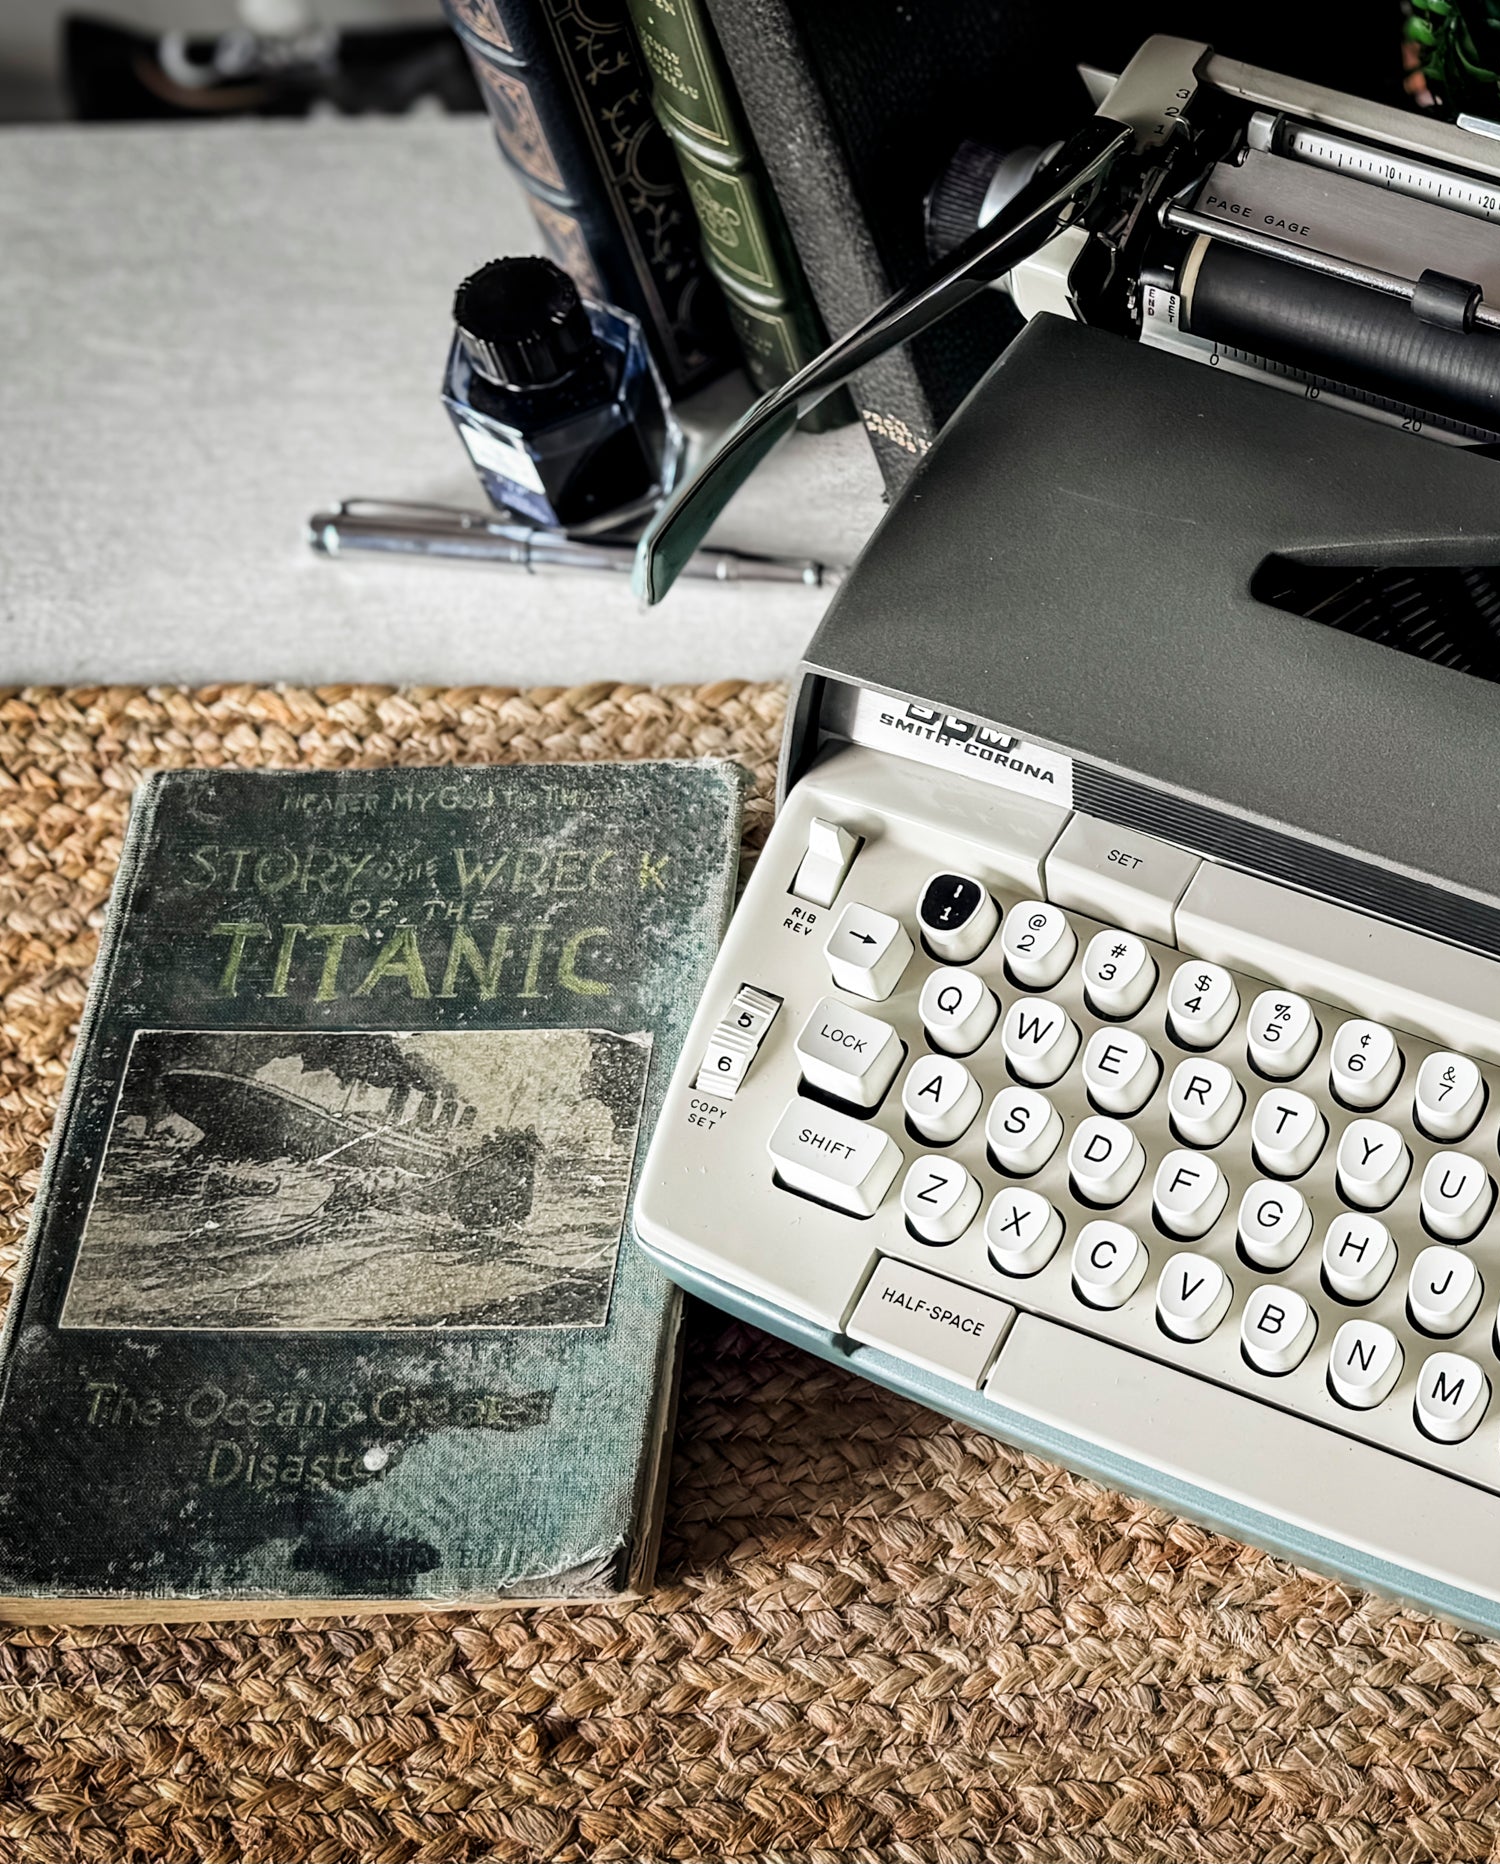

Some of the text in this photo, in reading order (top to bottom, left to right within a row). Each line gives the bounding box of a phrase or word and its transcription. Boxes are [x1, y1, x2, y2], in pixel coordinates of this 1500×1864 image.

[1176, 88, 1190, 99] 3
[1165, 107, 1179, 117] 2
[1154, 125, 1165, 135] 1
[1384, 164, 1396, 181] 10
[1482, 196, 1496, 211] 20
[1206, 196, 1311, 237] PAGE GAGE
[1147, 288, 1156, 316] END
[1168, 295, 1177, 323] SET
[1209, 353, 1423, 433] 0 10 20
[879, 712, 1055, 785] SMITH-CORONA
[391, 786, 434, 814] MY
[182, 844, 374, 897] STORY
[451, 845, 672, 899] WRECK
[1107, 849, 1144, 870] SET
[422, 899, 494, 922] THE
[791, 906, 817, 924] RIB
[939, 906, 952, 921] 1
[1028, 913, 1047, 931] @
[782, 917, 813, 936] REV
[1016, 934, 1036, 953] 2
[1110, 943, 1127, 959] #
[205, 921, 612, 1002] TITANIC
[1098, 963, 1117, 981] 3
[1194, 975, 1213, 992] $
[937, 986, 963, 1015] Q
[1183, 996, 1202, 1014] 4
[1273, 1003, 1292, 1022] %
[737, 1011, 755, 1028] 5
[1018, 1012, 1054, 1044] W
[1262, 1023, 1283, 1042] 5
[820, 1024, 868, 1054] LOCK
[717, 1055, 733, 1072] 6
[1097, 1044, 1128, 1075] E
[1347, 1053, 1367, 1072] 6
[917, 1075, 943, 1103] A
[1442, 1066, 1456, 1084] &
[1183, 1075, 1212, 1106] R
[1438, 1082, 1454, 1102] 7
[687, 1113, 716, 1131] SET
[689, 1098, 727, 1119] COPY
[1003, 1106, 1030, 1134] S
[1275, 1105, 1299, 1134] T
[798, 1128, 856, 1160] SHIFT
[1083, 1134, 1113, 1163] D
[1361, 1136, 1384, 1166] Y
[916, 1173, 949, 1204] Z
[1169, 1167, 1201, 1193] F
[1439, 1169, 1467, 1199] U
[1000, 1206, 1031, 1237] X
[1256, 1200, 1284, 1228] G
[1090, 1240, 1117, 1269] C
[1338, 1231, 1370, 1263] H
[1181, 1271, 1205, 1301] V
[1430, 1270, 1454, 1295] J
[881, 1287, 985, 1337] HALF-SPACE
[1256, 1303, 1286, 1334] B
[1346, 1339, 1377, 1372] N
[1431, 1371, 1465, 1406] M
[85, 1382, 164, 1430] The
